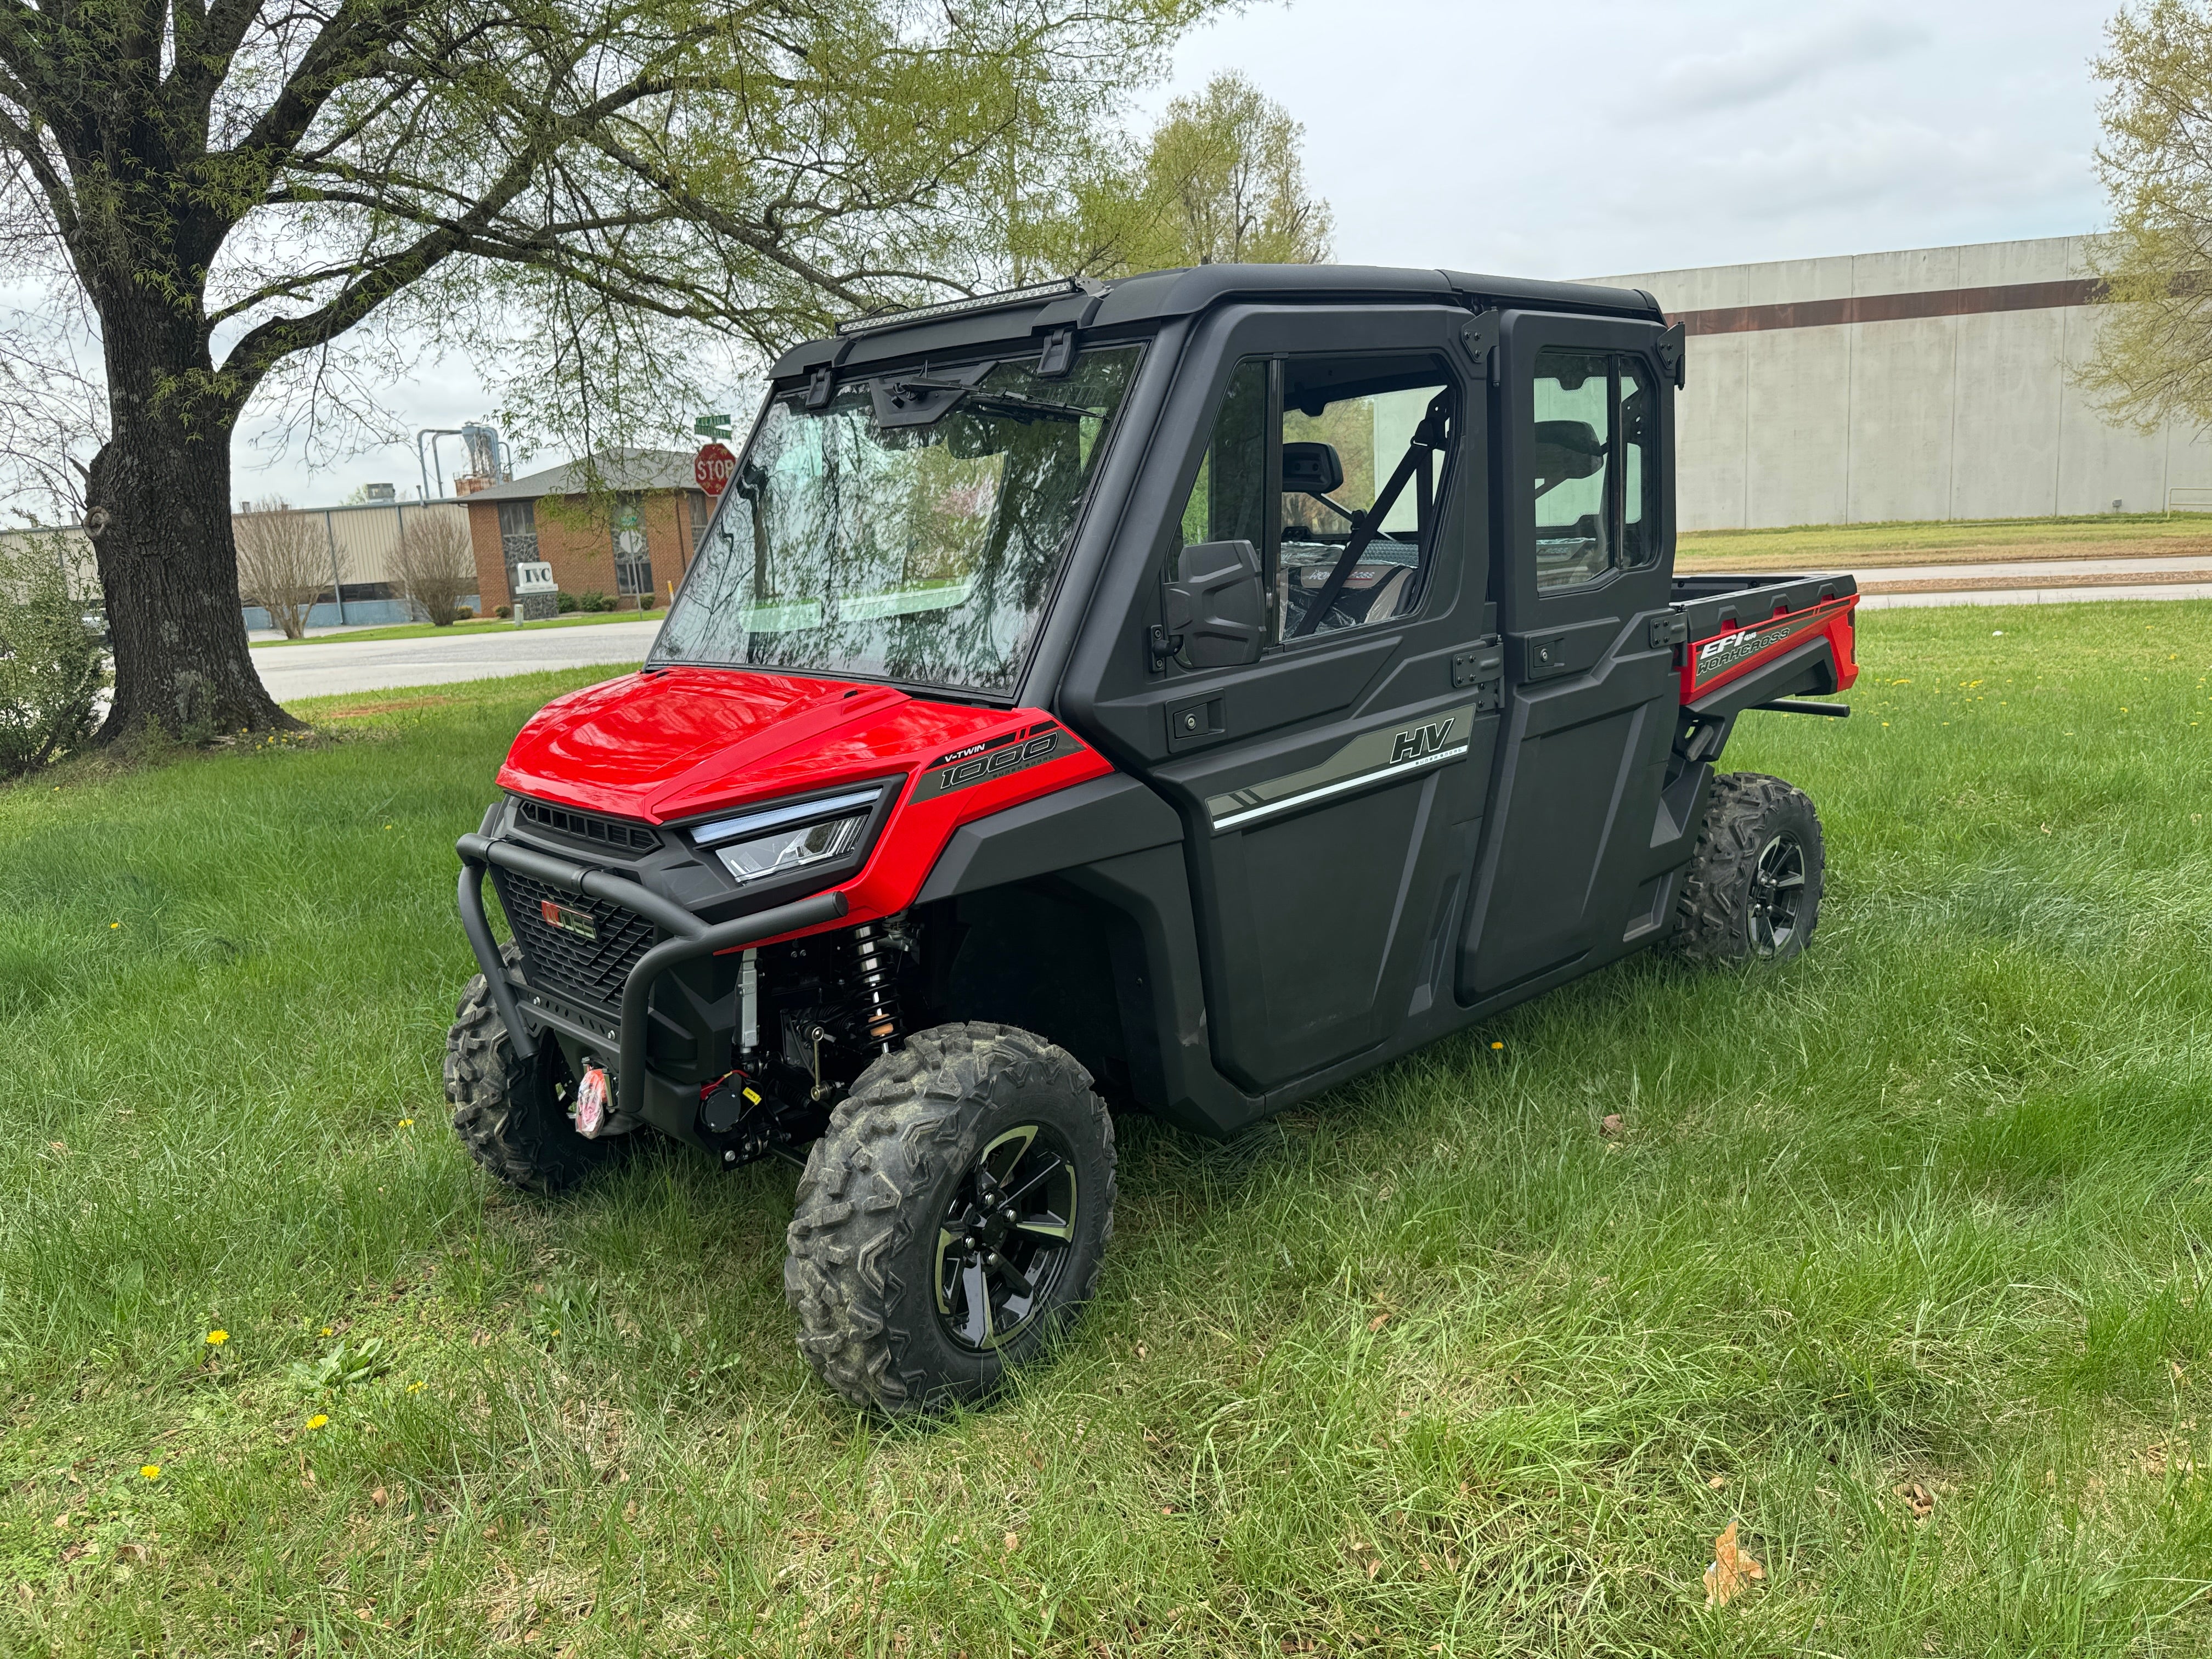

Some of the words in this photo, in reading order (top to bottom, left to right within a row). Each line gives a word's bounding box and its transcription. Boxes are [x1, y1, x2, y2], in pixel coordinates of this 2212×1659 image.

[697, 459, 735, 481] STOP
[524, 568, 551, 583] IVC
[1700, 630, 1746, 660] EFI
[944, 743, 986, 763] V-TWIN
[1389, 716, 1456, 765] HV
[940, 732, 1059, 789] 1000
